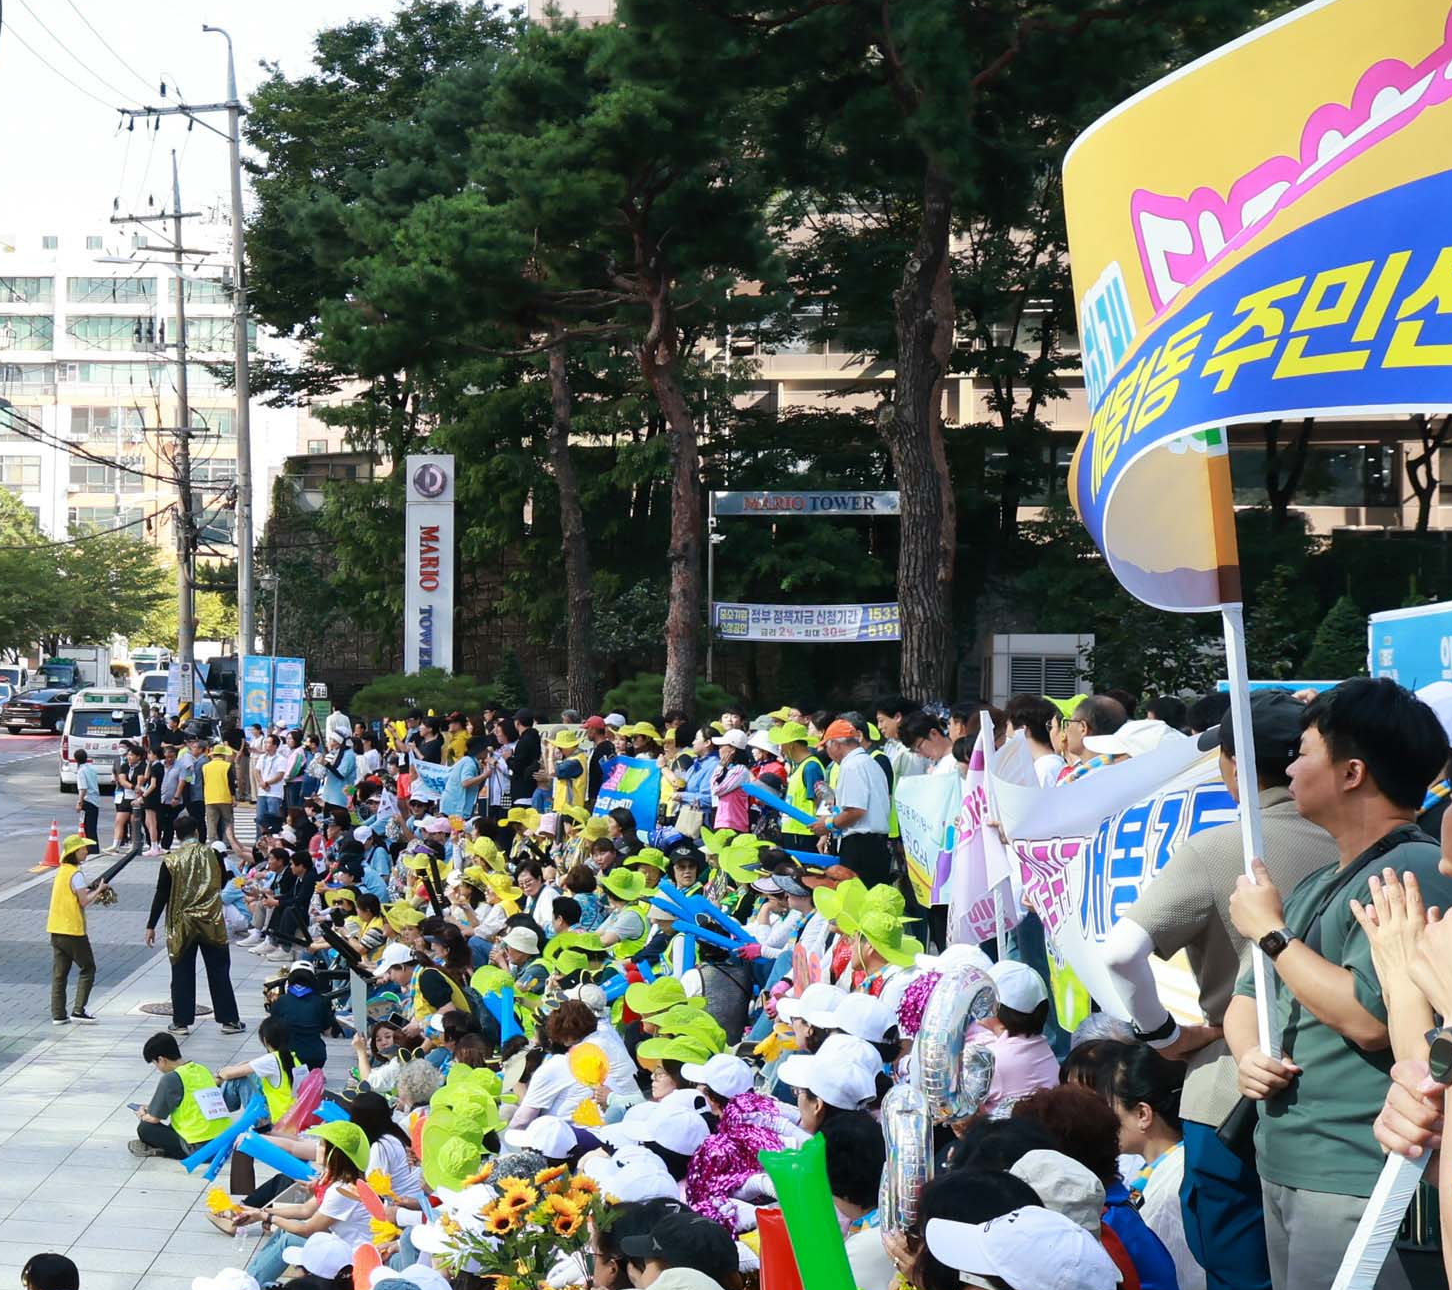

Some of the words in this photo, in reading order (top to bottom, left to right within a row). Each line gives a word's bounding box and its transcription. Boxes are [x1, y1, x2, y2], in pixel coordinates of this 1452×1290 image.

[742, 495, 806, 511] MARIO
[809, 495, 875, 511] TOWER
[419, 524, 440, 592] MARIO
[751, 610, 772, 624] 정부
[774, 610, 814, 625] 정책자금
[816, 610, 858, 625] 신청기간
